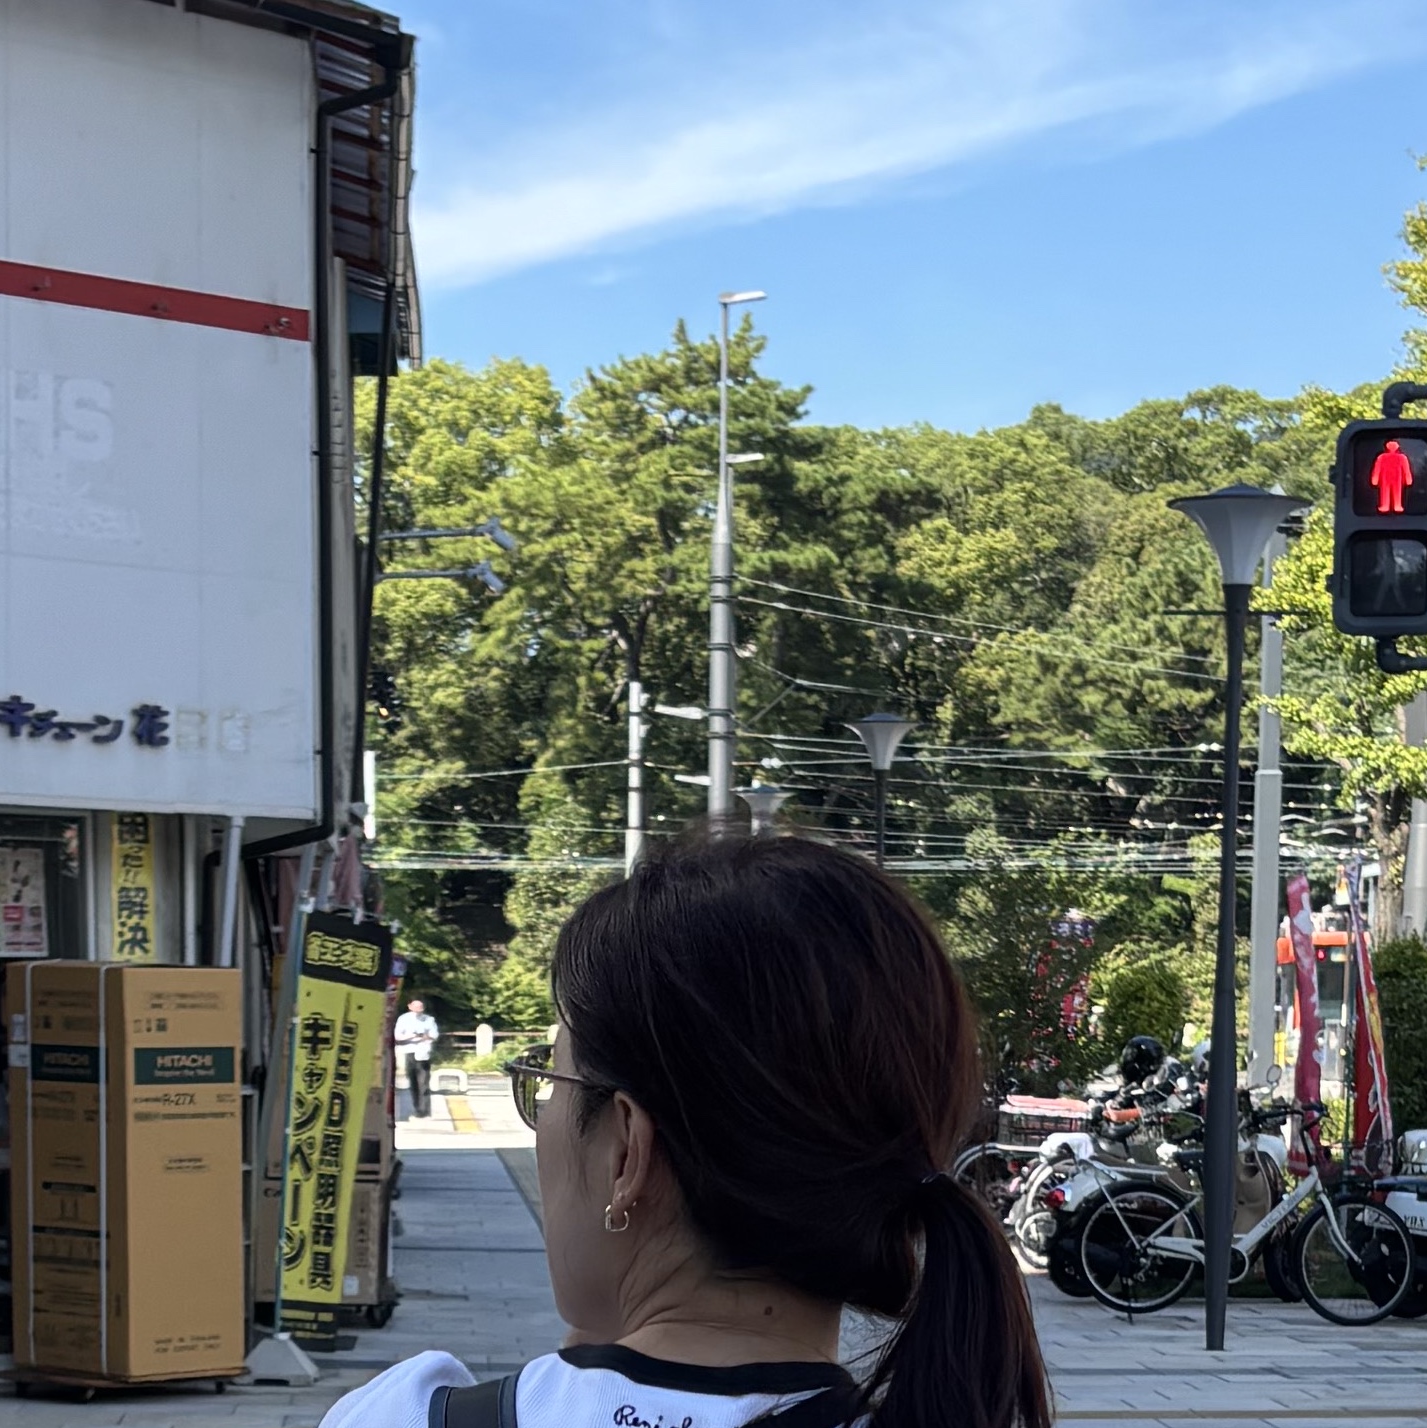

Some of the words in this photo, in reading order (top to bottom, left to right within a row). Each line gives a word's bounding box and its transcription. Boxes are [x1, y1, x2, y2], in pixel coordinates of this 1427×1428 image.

[156, 1054, 214, 1068] HITACHI
[281, 1012, 334, 1272] キャンペーン
